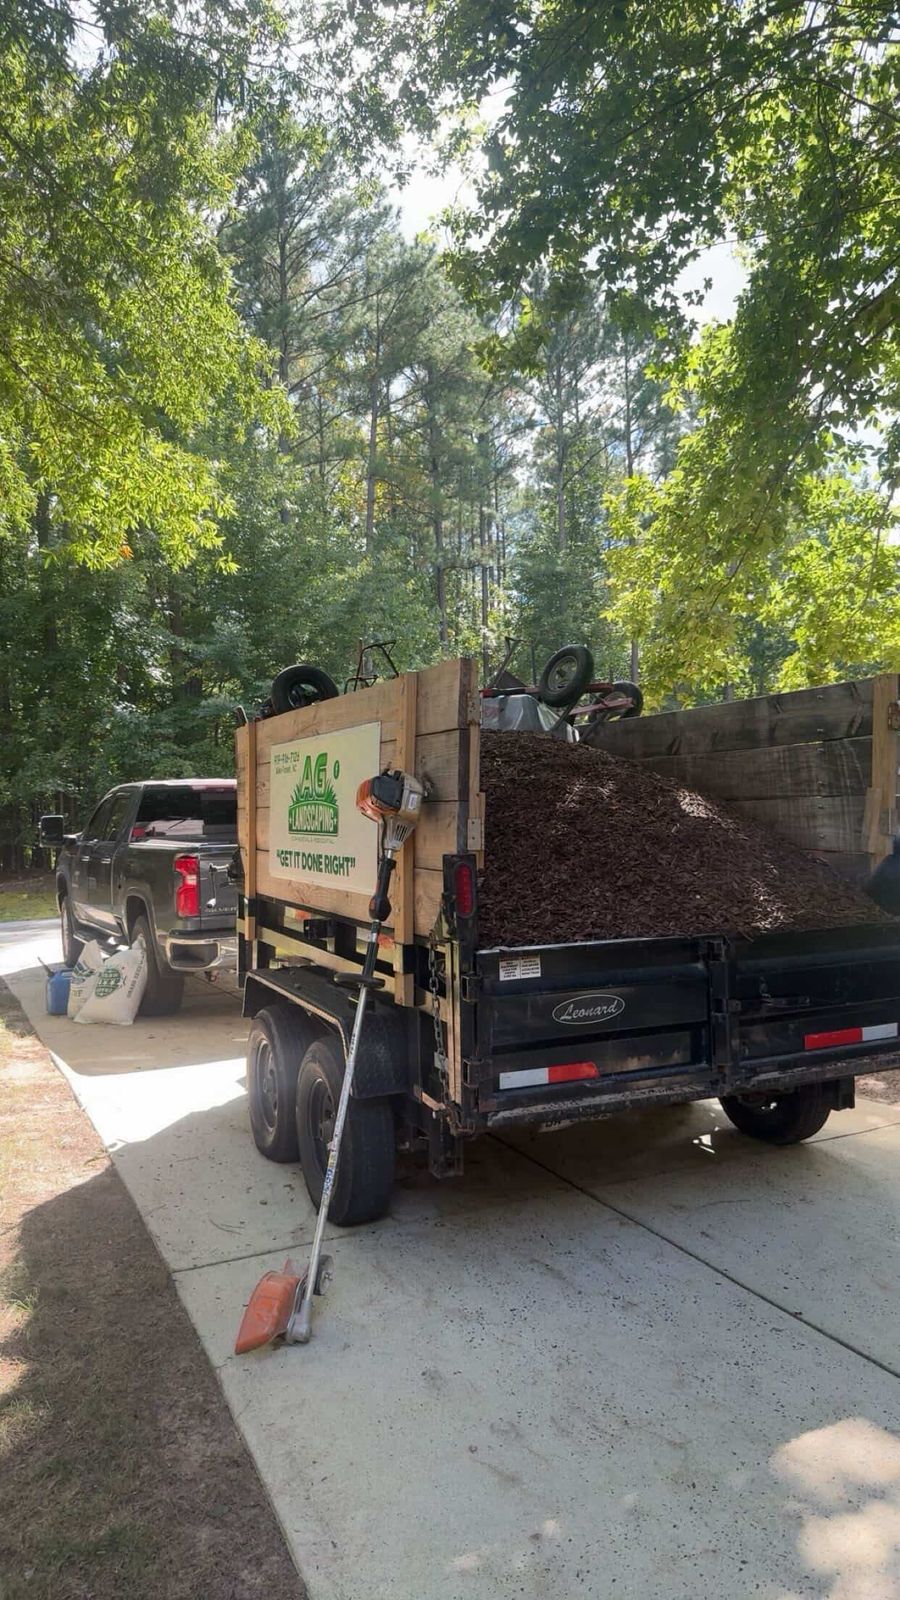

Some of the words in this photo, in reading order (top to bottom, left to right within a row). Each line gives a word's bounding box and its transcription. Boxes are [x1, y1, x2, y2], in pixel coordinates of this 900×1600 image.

[300, 752, 328, 800] AG
[291, 804, 334, 833] LANDSCAPING
[293, 850, 300, 869] IT
[301, 851, 324, 873] DONE
[559, 999, 618, 1020] Leonard
